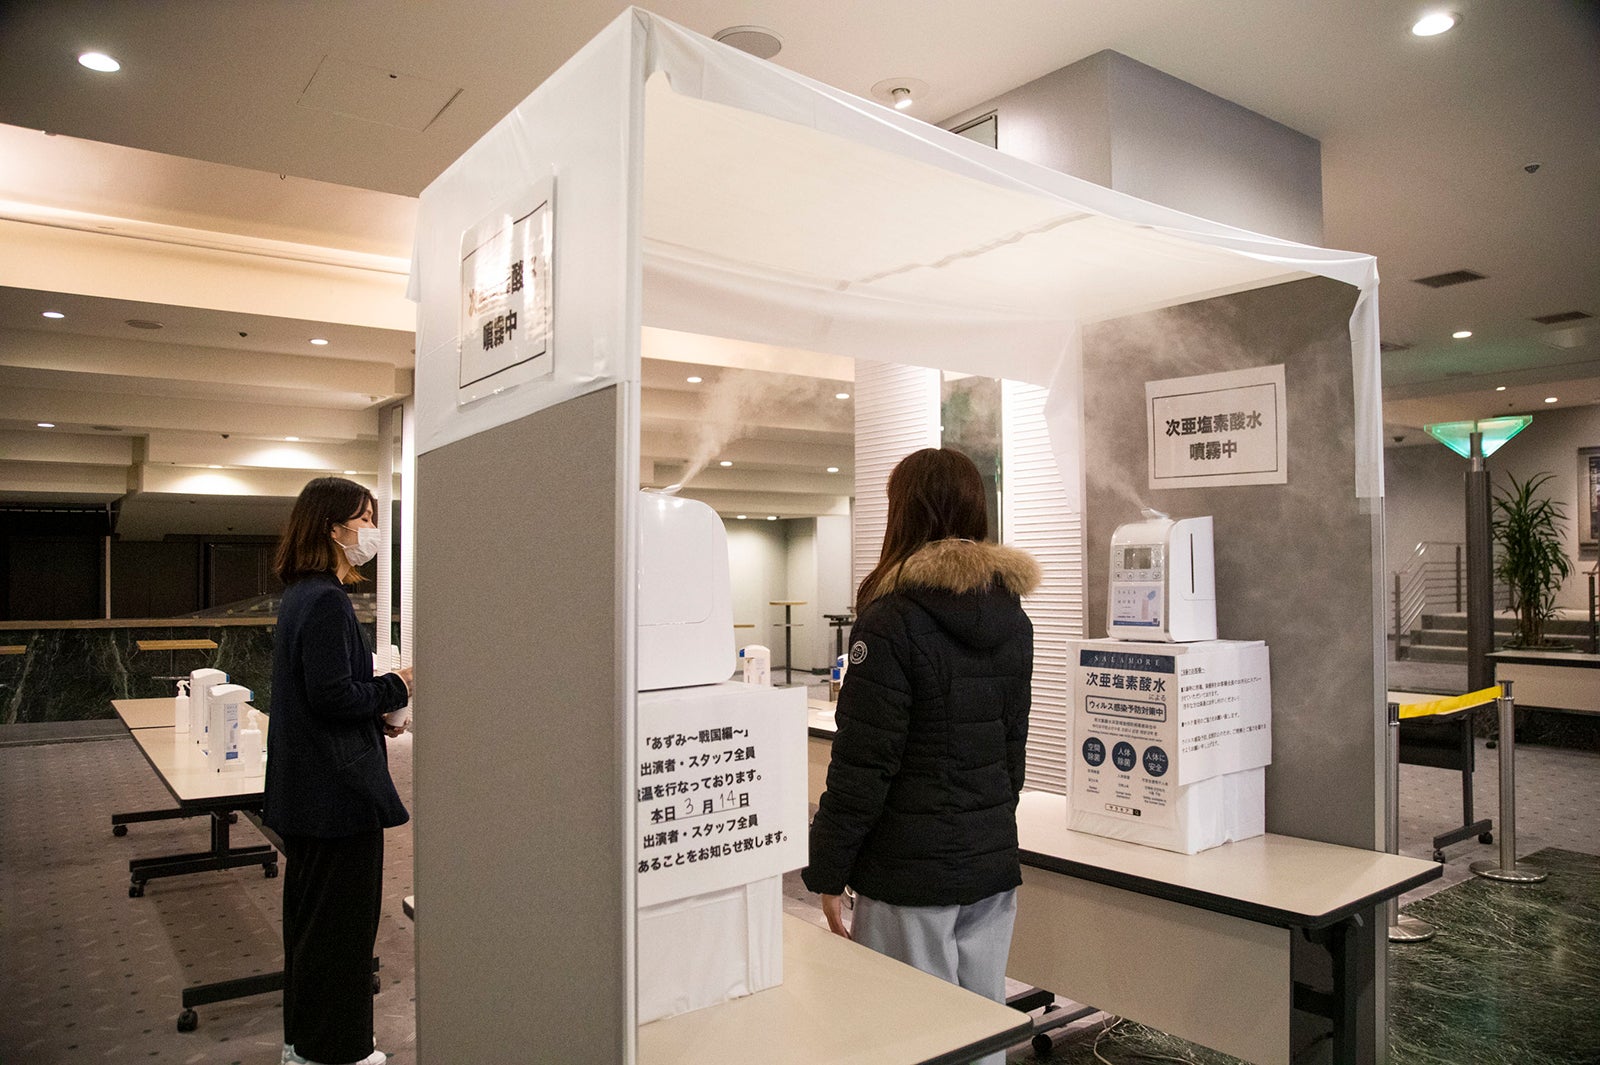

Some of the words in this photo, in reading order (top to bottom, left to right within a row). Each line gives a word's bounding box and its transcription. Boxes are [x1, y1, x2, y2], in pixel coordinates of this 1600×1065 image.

[483, 309, 517, 351] 噴霧中
[1165, 410, 1262, 437] 次亜塩素酸水
[1189, 440, 1237, 461] 噴霧中
[1086, 672, 1166, 693] 次亜塩素酸水
[1149, 693, 1166, 702] による
[1089, 700, 1163, 717] ウィルス感染予防対策中
[1087, 743, 1101, 753] 空間
[1117, 747, 1132, 757] 人体
[1146, 752, 1166, 763] 人体に
[640, 746, 756, 777] 出演者・スタッフ全員
[1148, 762, 1162, 773] 安全
[643, 814, 759, 849] 出演者・スタッフ全員
[638, 830, 787, 874] あることをお知らせ致します。
